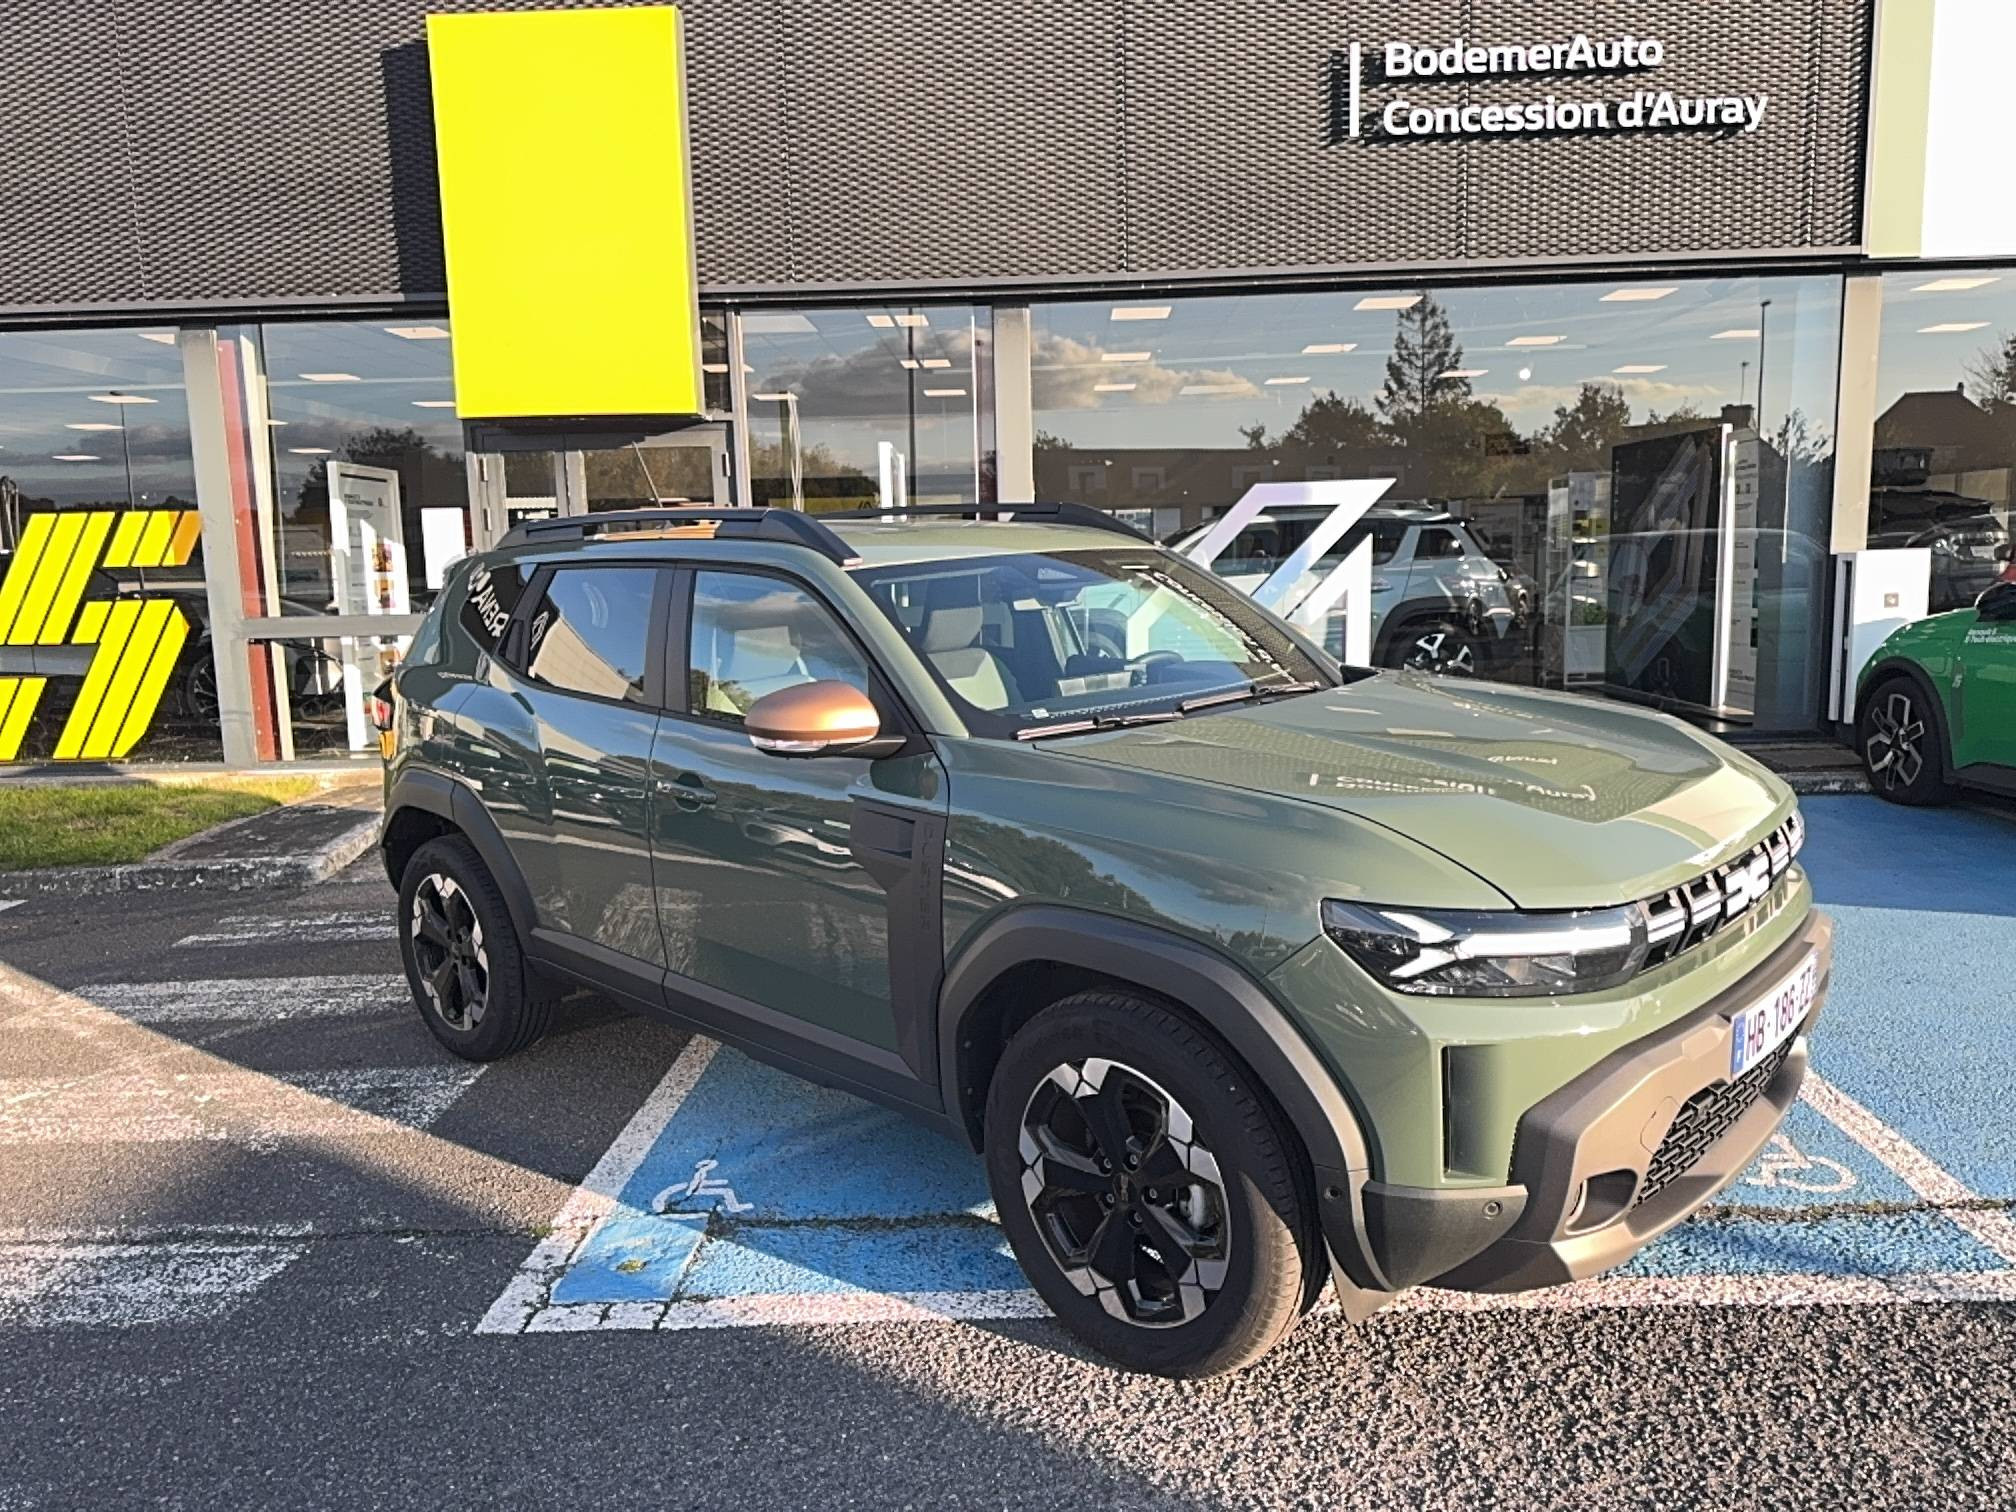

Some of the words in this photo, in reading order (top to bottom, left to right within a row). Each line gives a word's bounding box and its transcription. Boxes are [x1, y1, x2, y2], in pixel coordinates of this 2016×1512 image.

[1384, 35, 1664, 77] BodemerAuto
[1383, 96, 1607, 136] Concession
[1617, 91, 1769, 131] d'Auray
